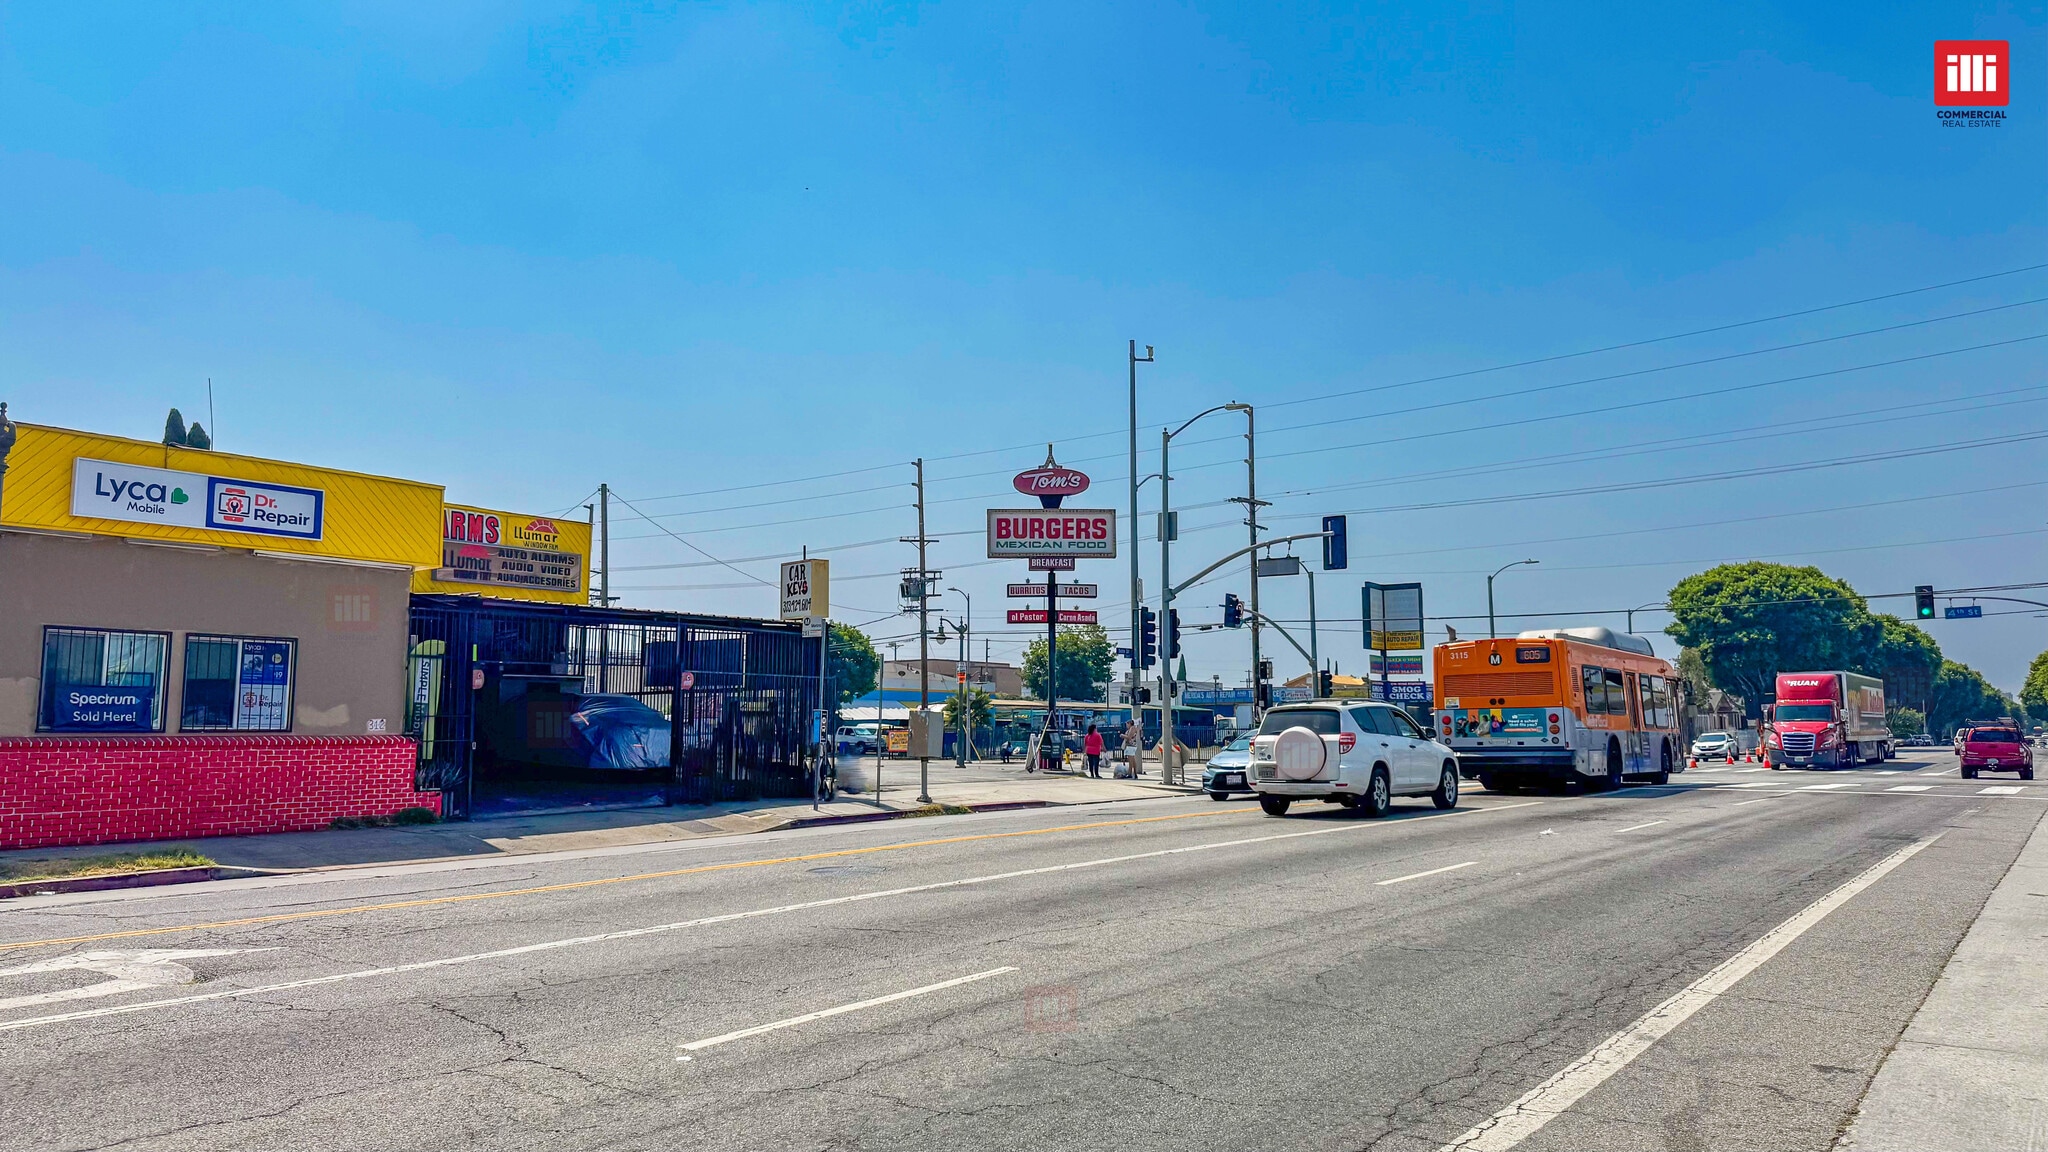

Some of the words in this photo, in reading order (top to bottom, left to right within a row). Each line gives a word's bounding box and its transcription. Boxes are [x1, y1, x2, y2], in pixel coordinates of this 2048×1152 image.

[1021, 472, 1081, 491] Tom's
[95, 472, 167, 504] Lyca
[254, 493, 278, 509] Dr.
[126, 501, 166, 515] Mobile
[253, 508, 311, 527] Repair
[996, 518, 1107, 540] BURGERS
[523, 541, 548, 550] WINDOW
[996, 541, 1062, 549] MEXICAN
[1068, 541, 1107, 549] FOOD
[498, 549, 527, 560] AUTO
[531, 552, 575, 565] ALARMS
[1031, 558, 1073, 567] BREAKFAST
[501, 561, 534, 572] AUDIO
[540, 565, 571, 576] VIDEO
[788, 564, 806, 581] CAR
[787, 581, 808, 598] KEYS
[1010, 586, 1046, 594] BURRITOS
[1064, 586, 1090, 595] TACOS
[1019, 612, 1044, 621] Pastor
[1059, 613, 1076, 621] Carne
[1077, 613, 1096, 621] Asada
[1948, 608, 1965, 616] 4th
[1450, 652, 1469, 660] 3115
[69, 692, 136, 707] Spectrum
[1219, 690, 1236, 698] REPAIR
[73, 711, 101, 722] Sold
[103, 711, 136, 722] Here!
[369, 719, 385, 730] 312
